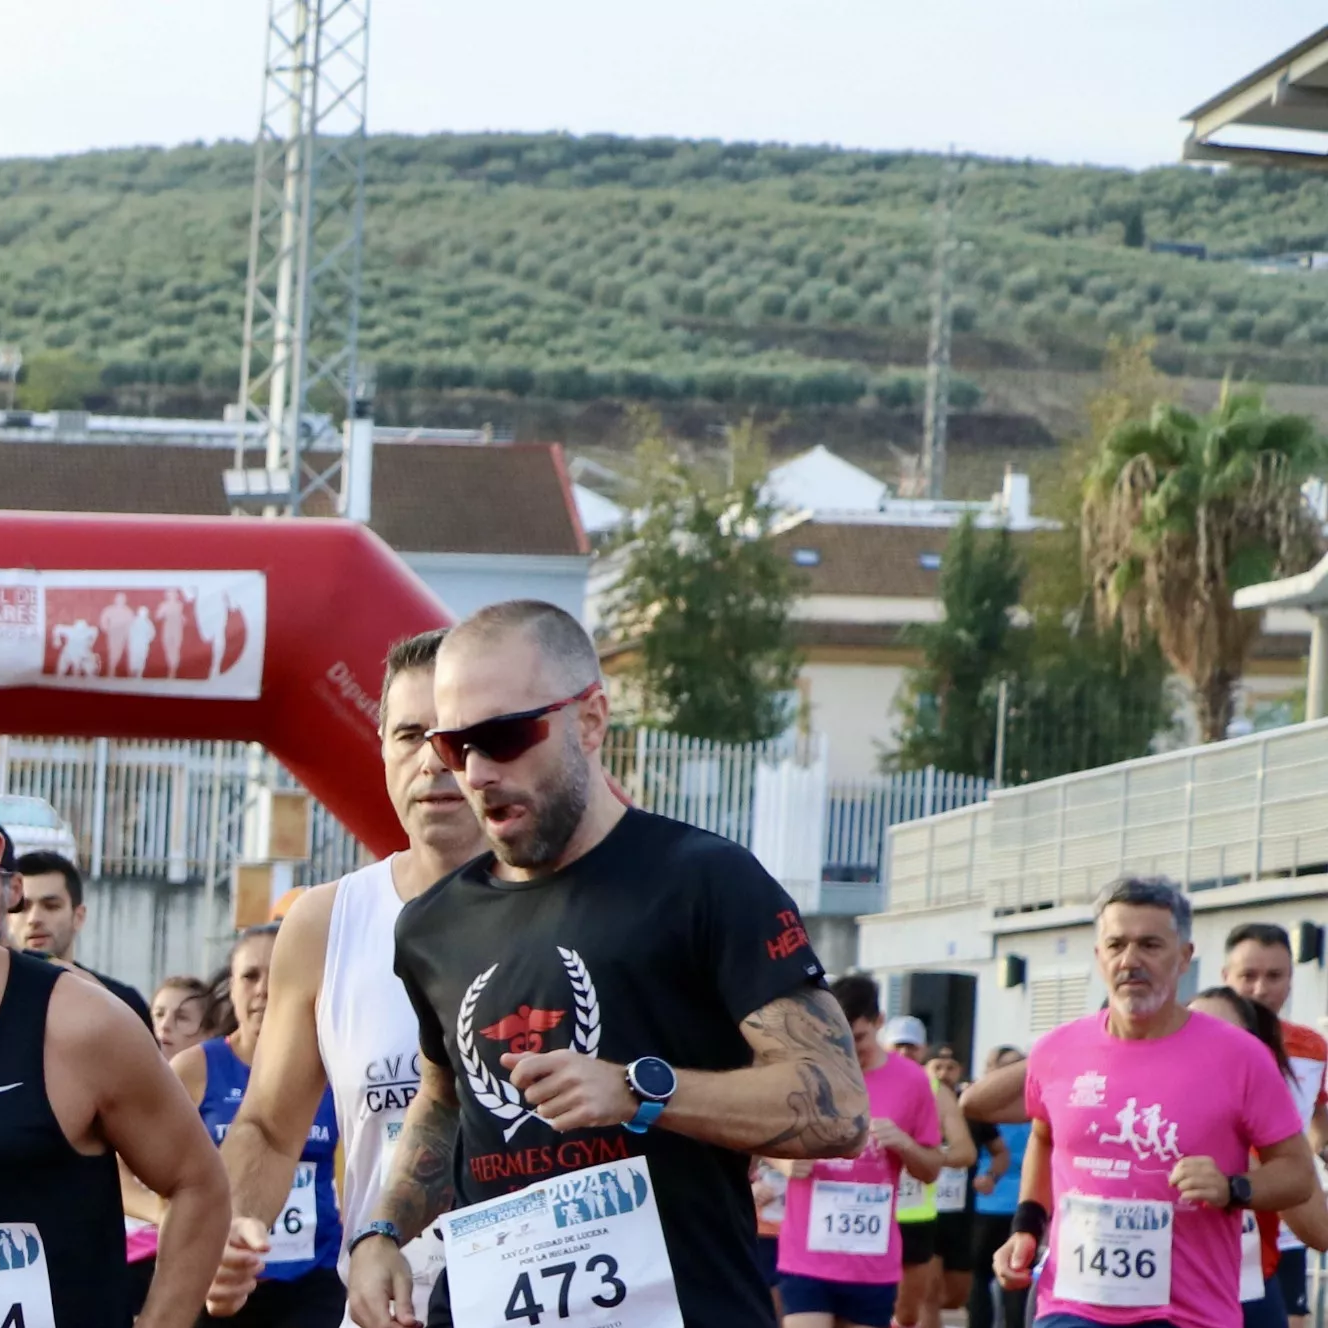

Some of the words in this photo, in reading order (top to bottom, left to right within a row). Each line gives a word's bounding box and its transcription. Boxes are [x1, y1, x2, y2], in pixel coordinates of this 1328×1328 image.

[15, 585, 38, 604] DE
[470, 1144, 555, 1183] HERMES
[557, 1135, 629, 1169] GYM
[546, 1171, 603, 1204] 2024
[824, 1213, 881, 1235] 1350
[534, 1237, 564, 1251] CIUDAD
[565, 1233, 577, 1245] DE
[536, 1252, 547, 1262] LA
[1073, 1243, 1158, 1279] 1436
[504, 1253, 628, 1326] 473
